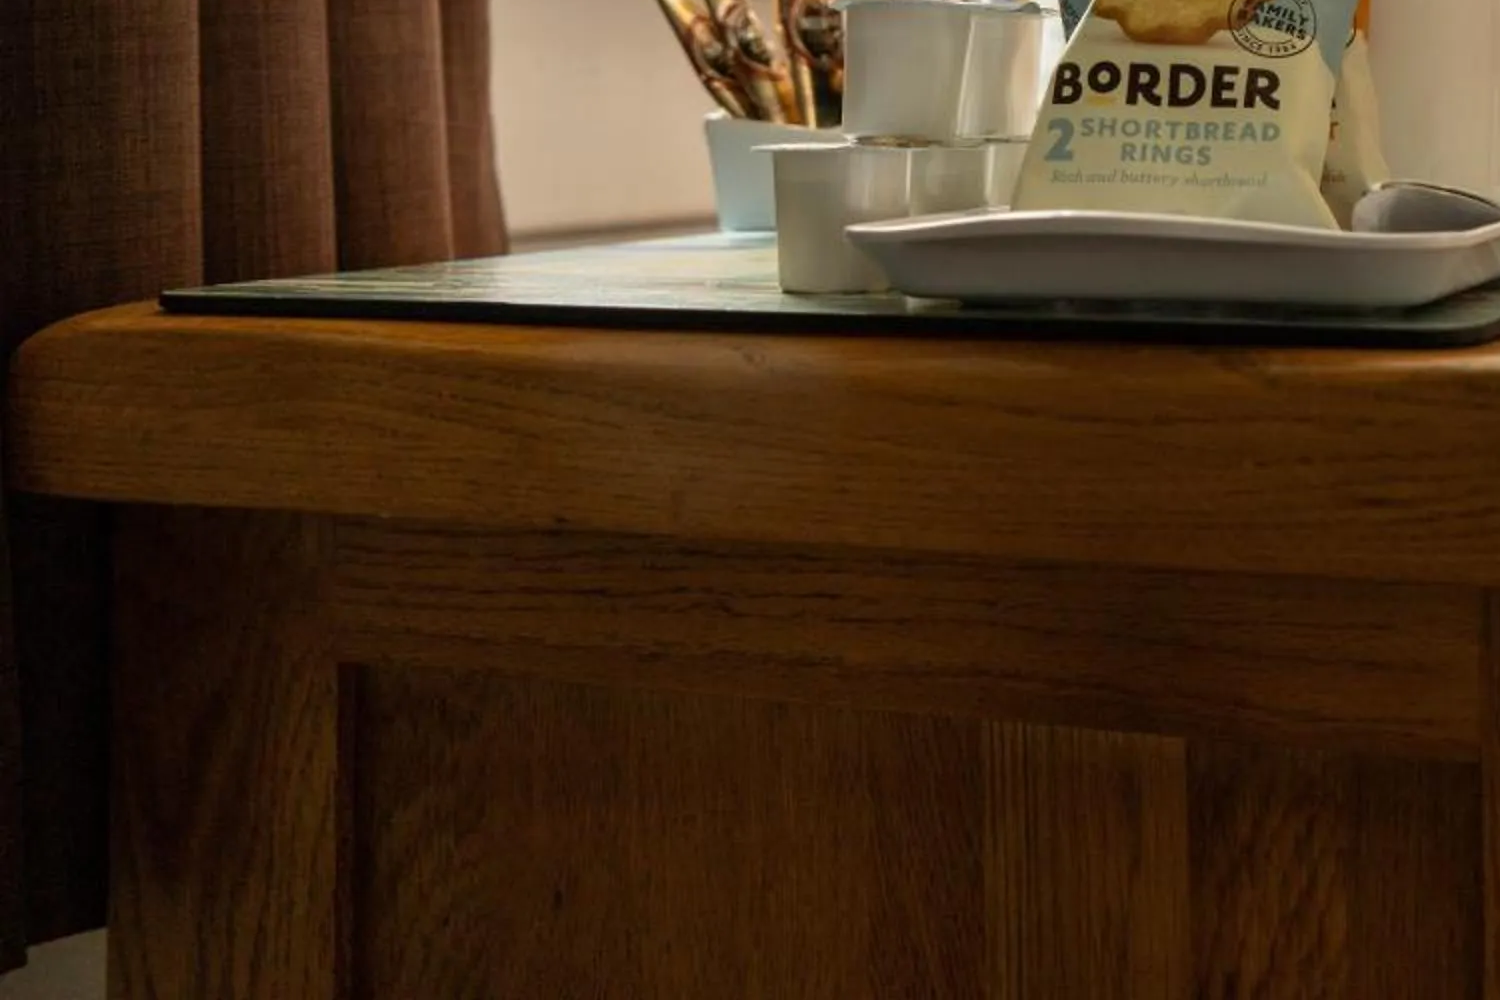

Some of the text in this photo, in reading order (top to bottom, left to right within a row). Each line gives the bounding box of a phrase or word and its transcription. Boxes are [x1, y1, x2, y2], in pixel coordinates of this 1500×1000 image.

[1052, 60, 1281, 111] BORDER
[1044, 117, 1281, 162] 2 SHORTBREAD
[1120, 142, 1212, 166] RINGS
